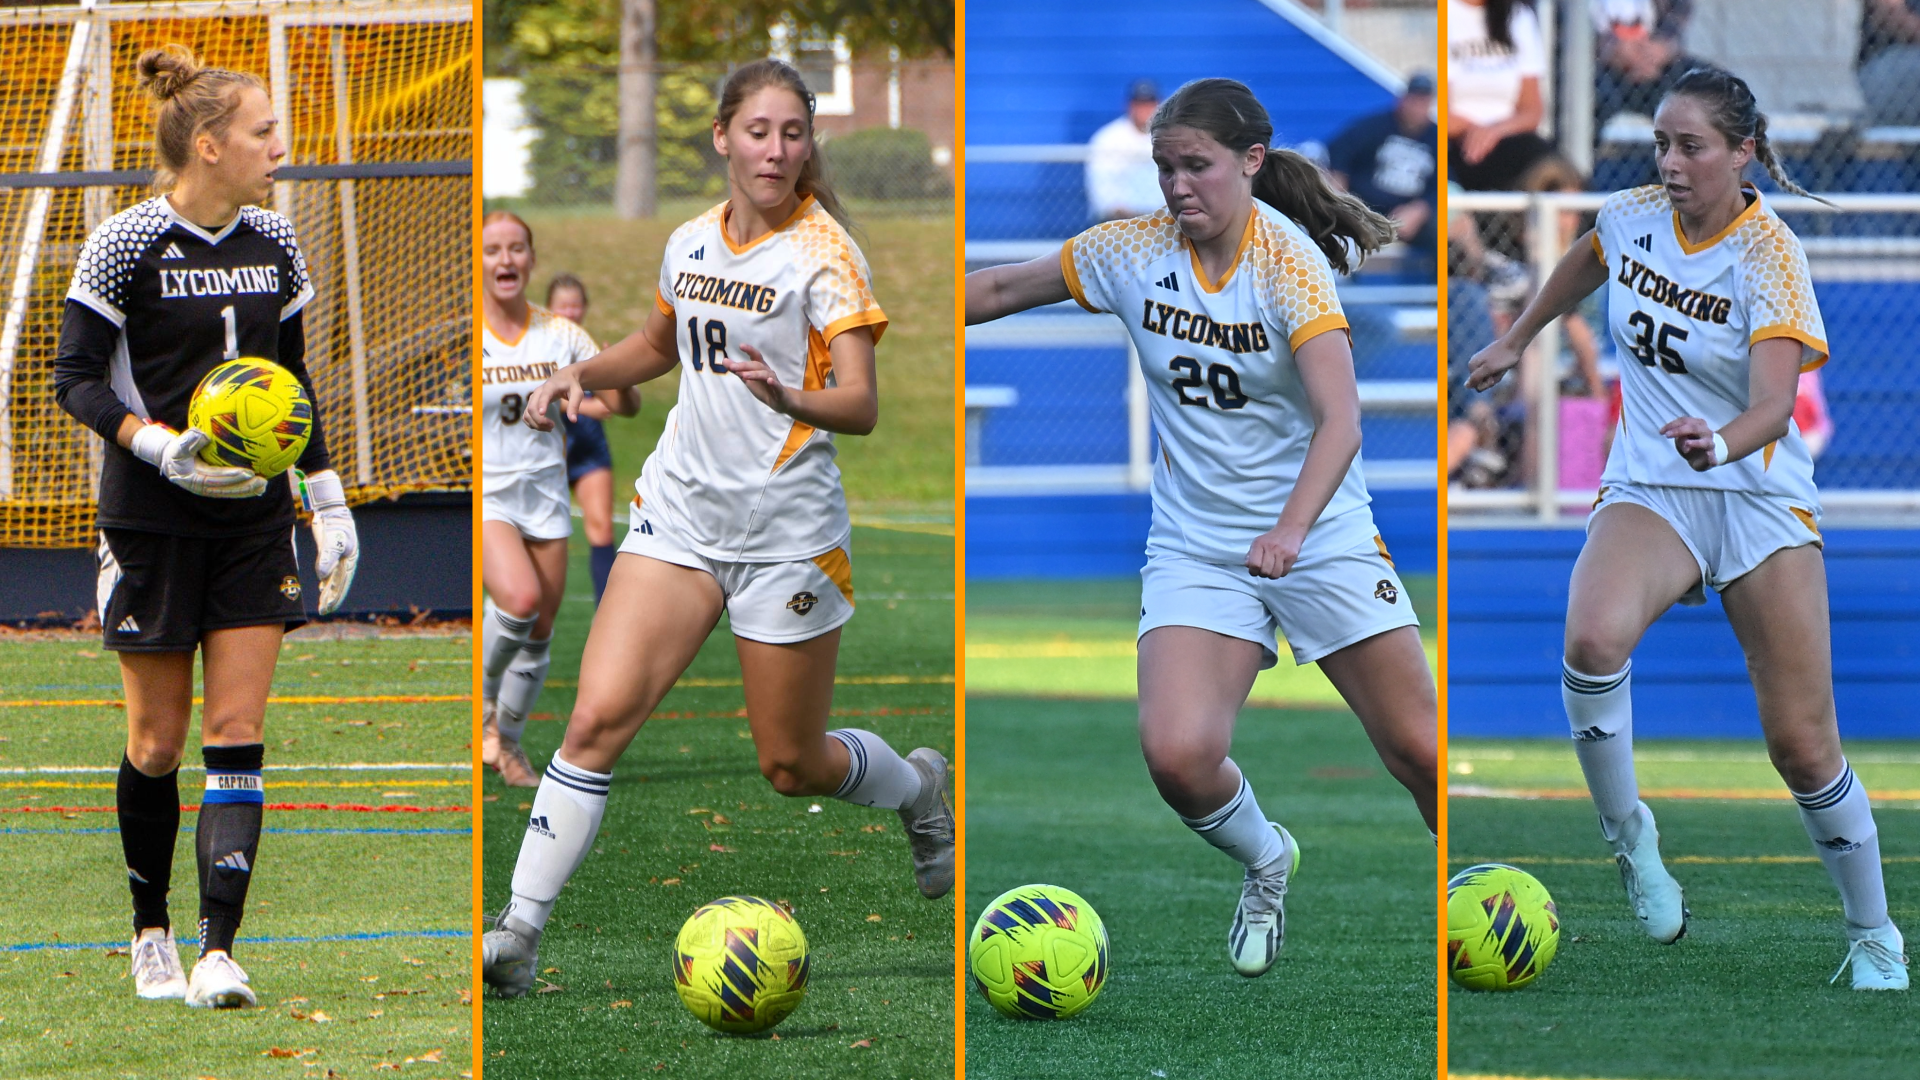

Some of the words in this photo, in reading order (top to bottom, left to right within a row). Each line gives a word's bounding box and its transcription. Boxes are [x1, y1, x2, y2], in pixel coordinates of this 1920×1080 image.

[159, 265, 279, 298] LYCOMING
[673, 271, 777, 313] LYCOMING
[1617, 253, 1732, 325] LYCOMING
[220, 304, 239, 360] 1
[687, 316, 729, 375] 18
[1628, 309, 1689, 375] 35
[482, 361, 559, 384] YCOMING
[1169, 355, 1249, 410] 20
[218, 775, 258, 789] CAPTAIN
